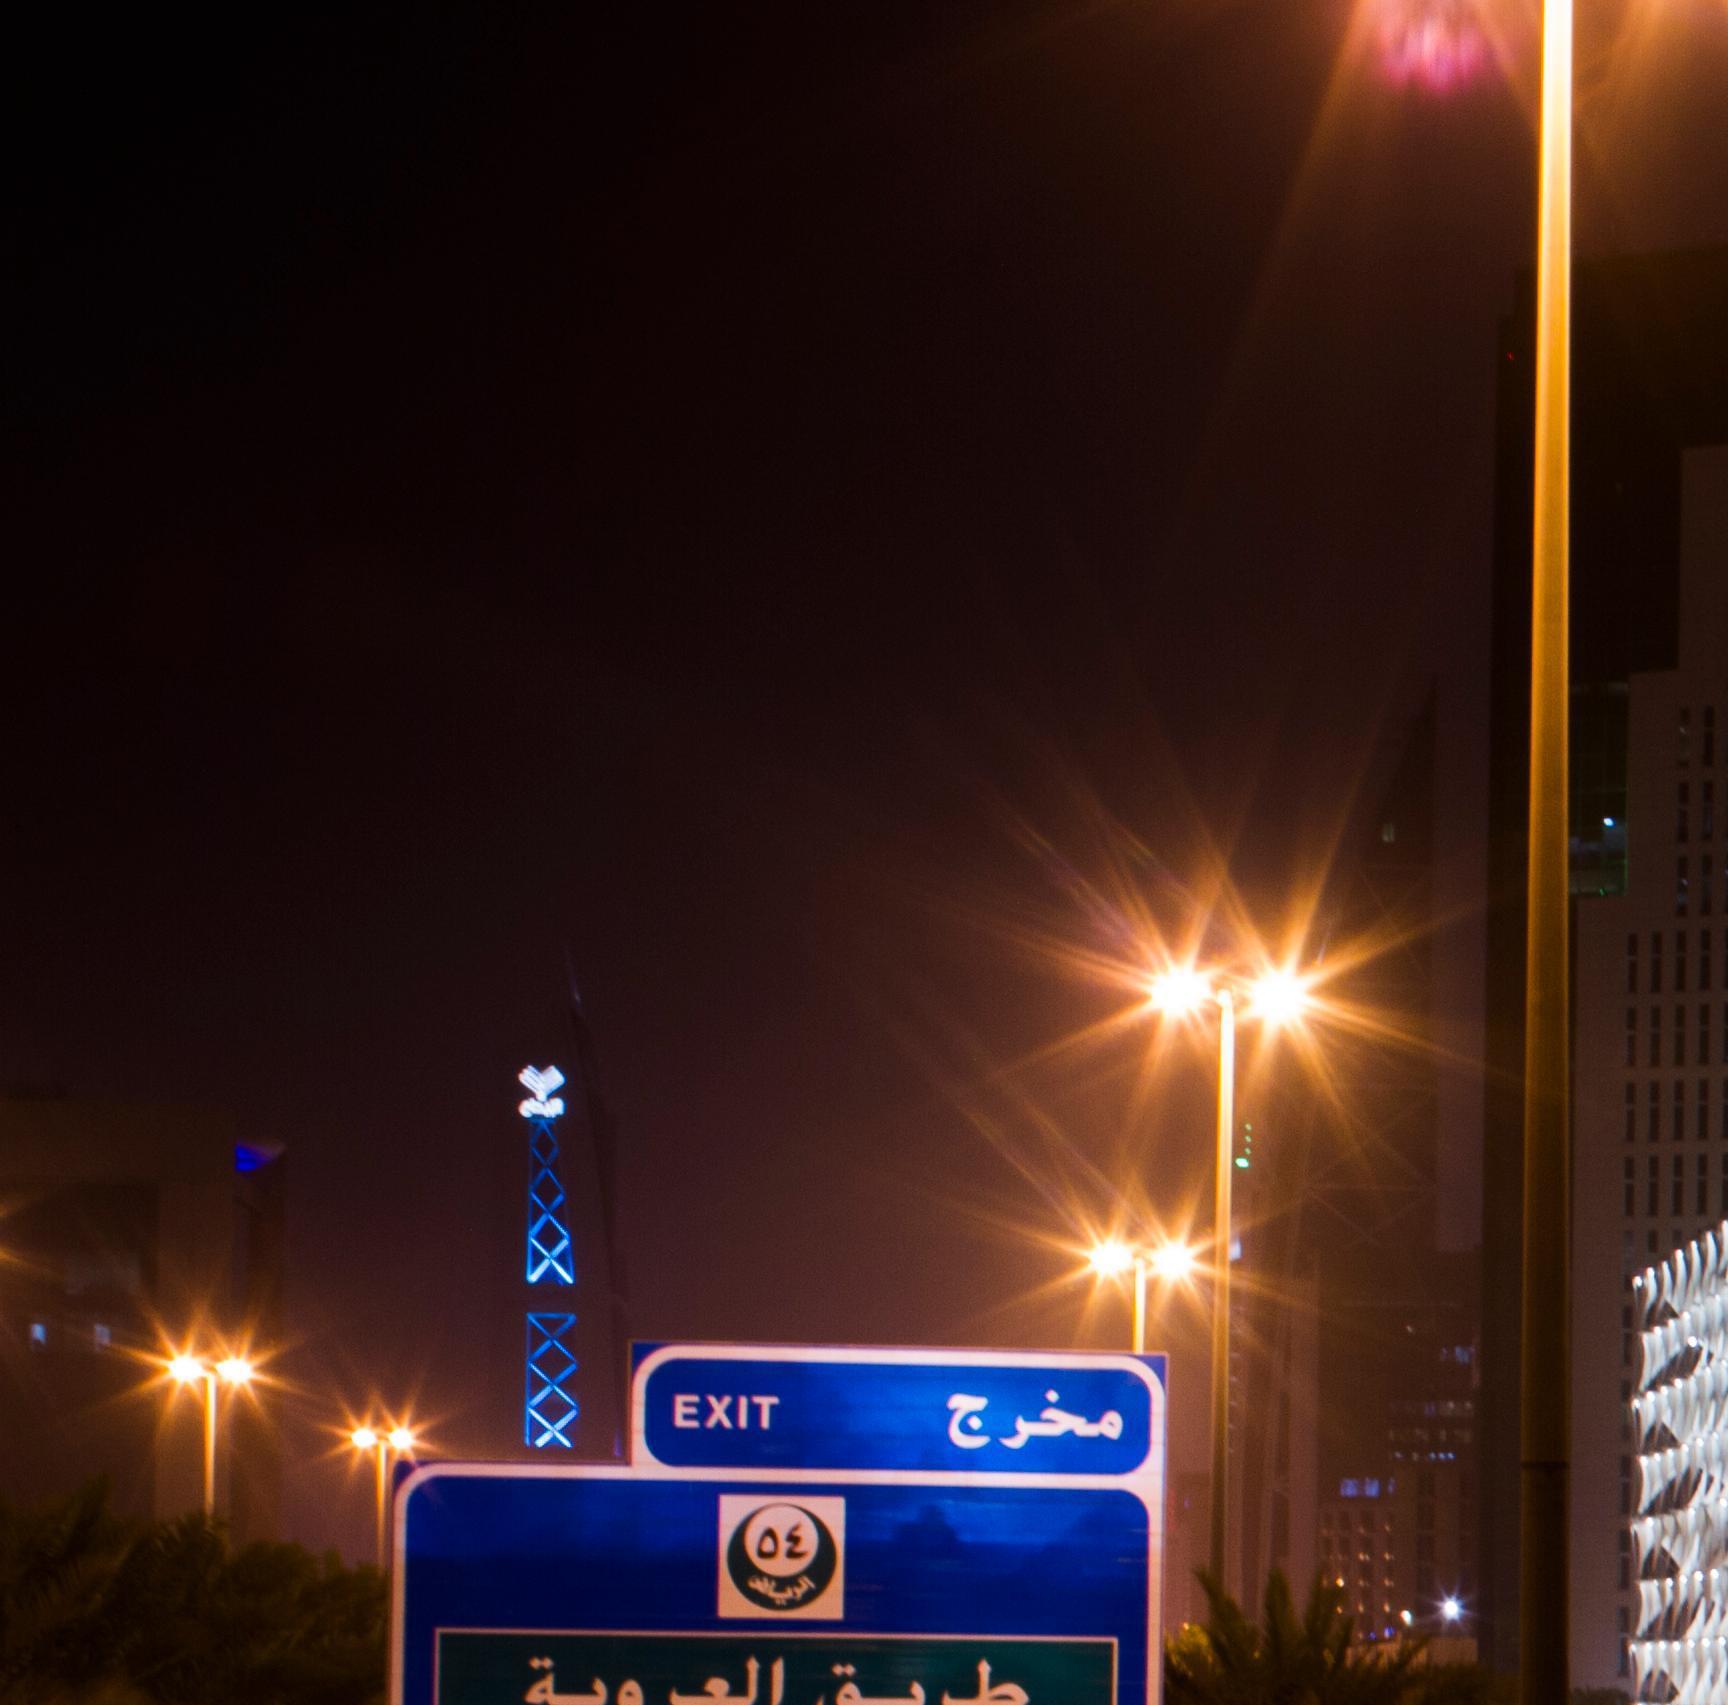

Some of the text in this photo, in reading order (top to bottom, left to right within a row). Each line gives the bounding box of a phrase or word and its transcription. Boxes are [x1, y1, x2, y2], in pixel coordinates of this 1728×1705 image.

[673, 1394, 779, 1430] EXIT
[946, 1389, 1123, 1449] مخرج
[755, 1526, 805, 1560] ٥٤
